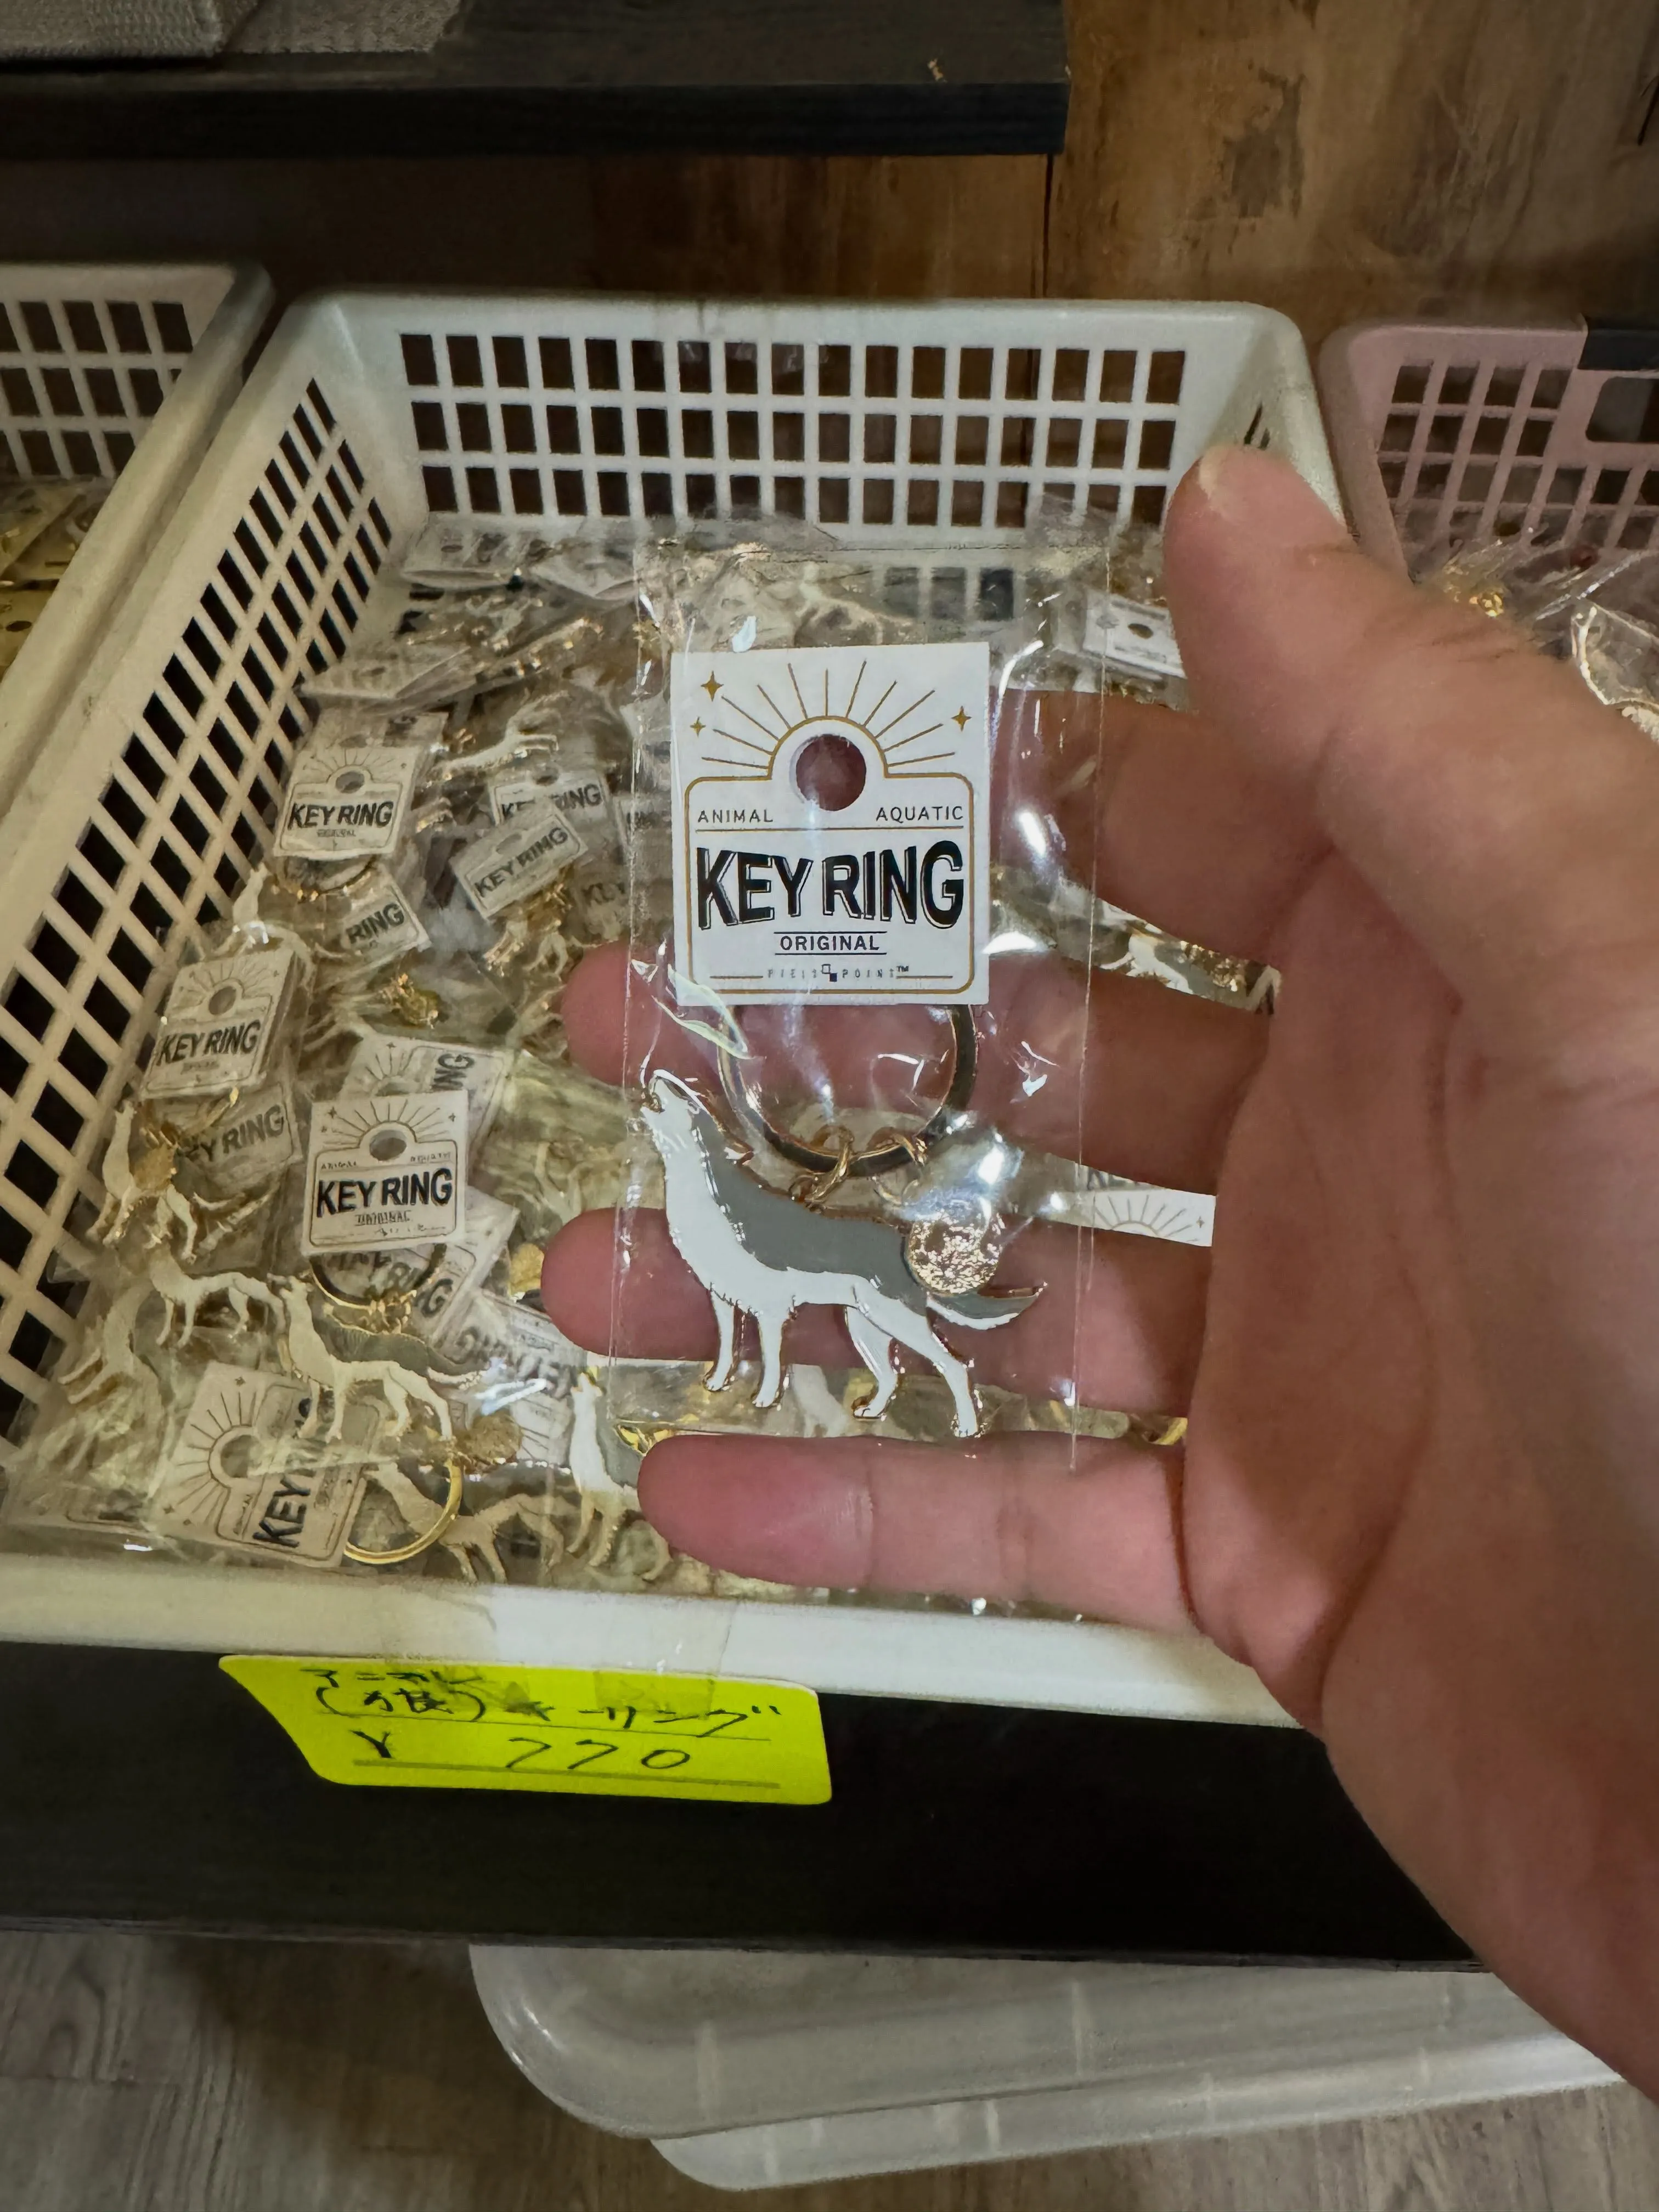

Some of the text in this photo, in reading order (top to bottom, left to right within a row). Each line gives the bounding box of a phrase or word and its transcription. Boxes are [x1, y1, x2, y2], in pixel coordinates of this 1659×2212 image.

[287, 801, 394, 830] KEY RING
[697, 806, 963, 824] ANIMAL AQUATIC
[696, 840, 964, 930] KEY RING
[346, 902, 404, 944] RING
[780, 935, 880, 951] ORIGINAL
[156, 1019, 261, 1066] KEY RING
[222, 1104, 284, 1154] RING
[317, 1167, 453, 1218] KEY RING
[506, 1737, 691, 1770] 770
